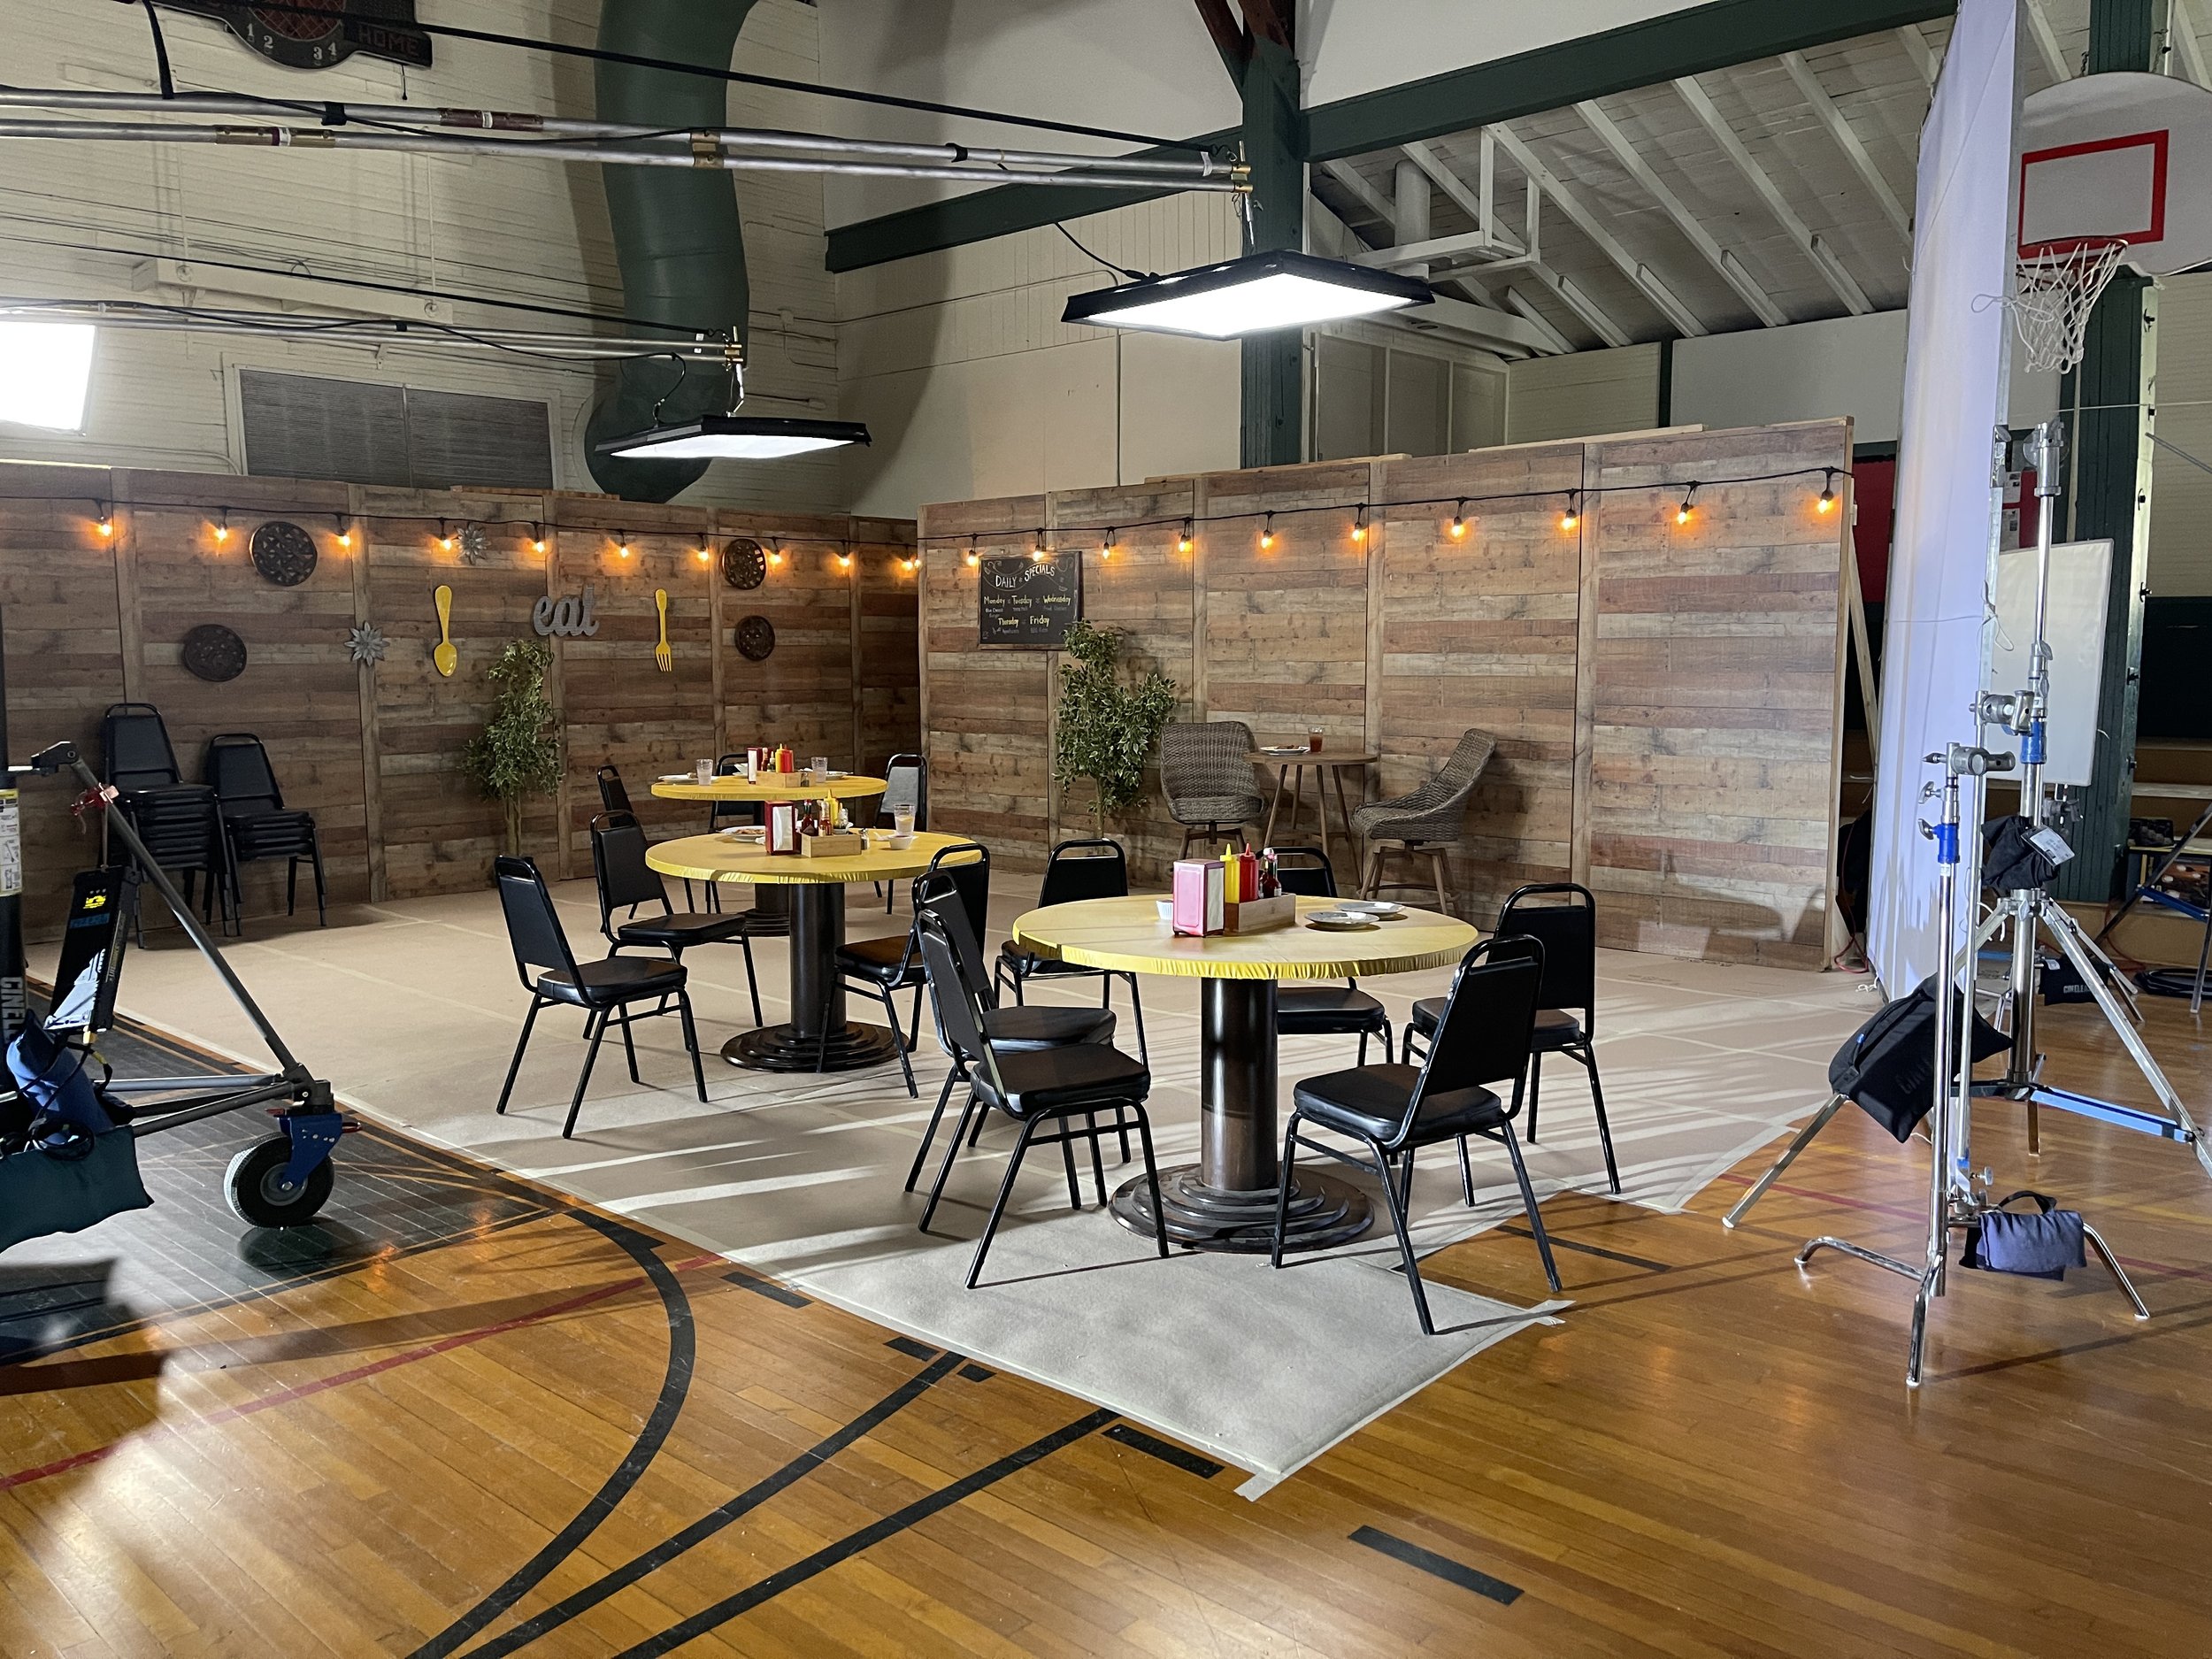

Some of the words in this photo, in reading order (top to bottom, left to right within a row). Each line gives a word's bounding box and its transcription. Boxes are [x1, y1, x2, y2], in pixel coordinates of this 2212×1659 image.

[246, 23, 255, 37] 1
[263, 35, 273, 49] 2
[313, 47, 322, 60] 3
[327, 42, 337, 56] 4
[357, 23, 419, 57] HOME
[995, 575, 1017, 588] DAILY
[1025, 565, 1055, 581] SPECIALS
[534, 583, 600, 637] eat
[984, 594, 1005, 607] Monday
[1011, 594, 1033, 608] Tuesday
[1043, 594, 1071, 605] Wednesday
[997, 616, 1019, 628] Thursday
[1029, 614, 1050, 627] Friday
